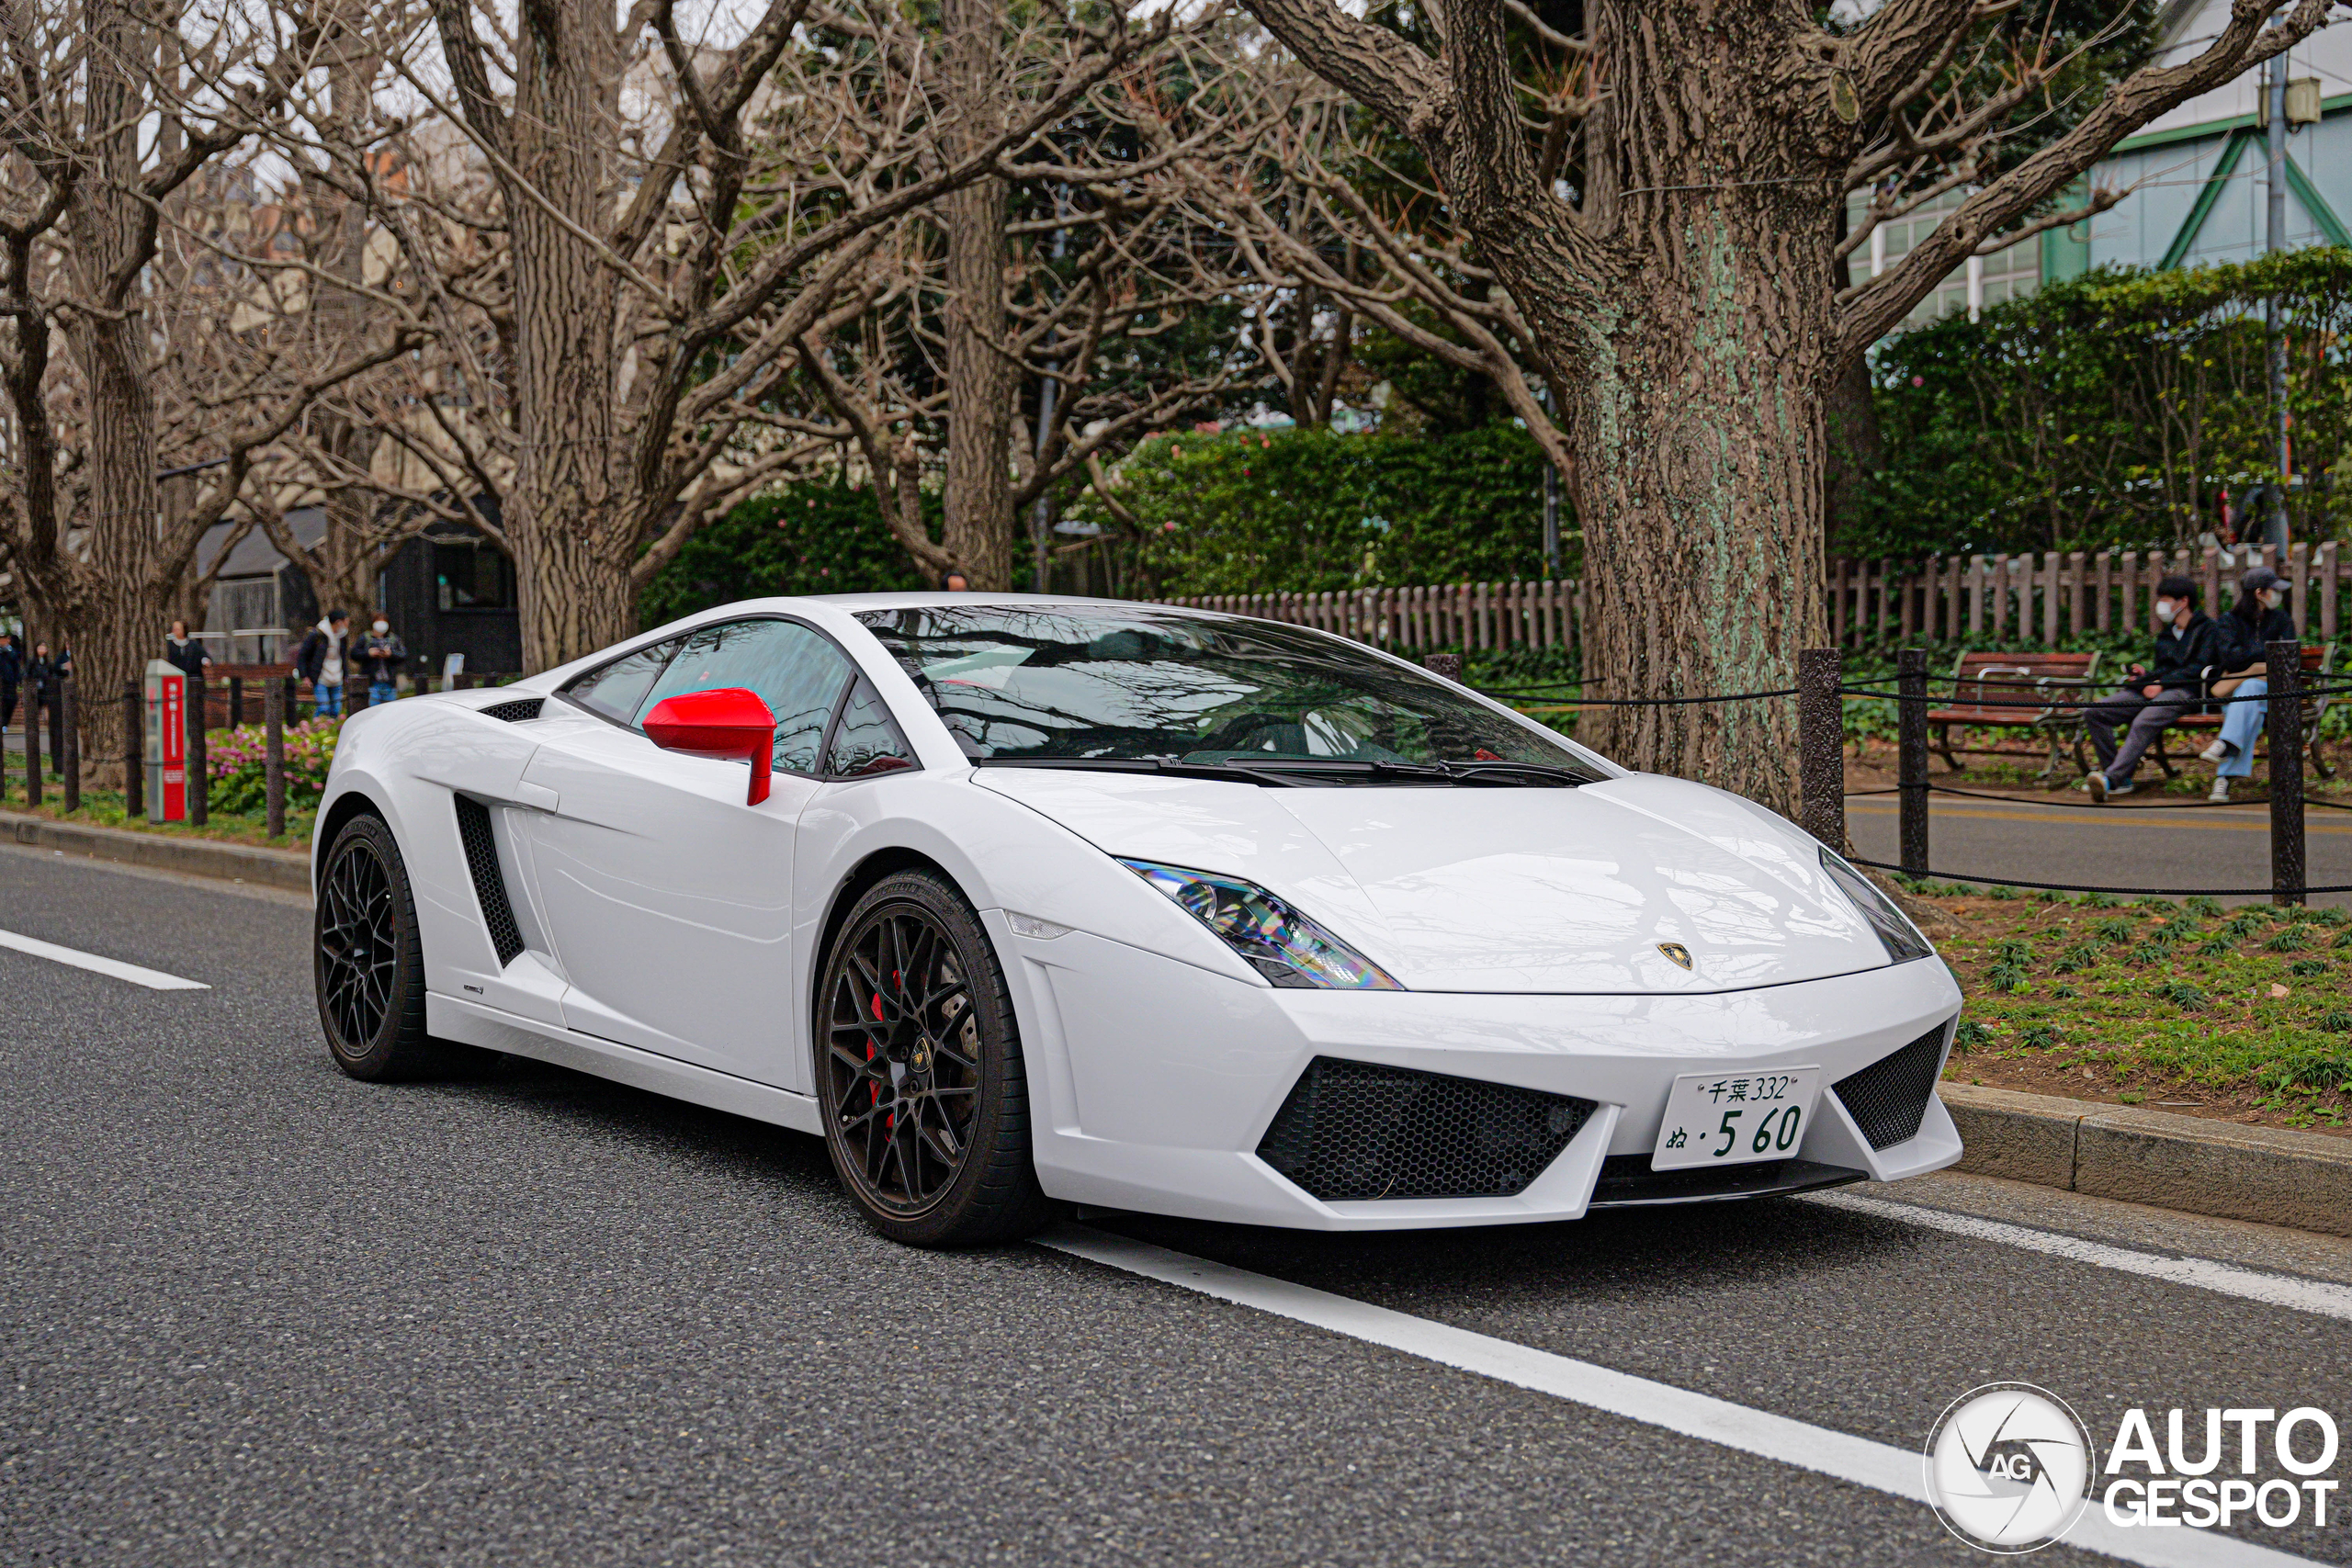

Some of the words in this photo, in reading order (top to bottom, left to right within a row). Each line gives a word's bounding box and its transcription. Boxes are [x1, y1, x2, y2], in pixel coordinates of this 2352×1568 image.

[871, 883, 918, 900] MICHELIN
[1708, 1078, 1750, 1104] 千葉
[1750, 1076, 1789, 1100] 332
[1666, 1126, 1688, 1148] ぬ
